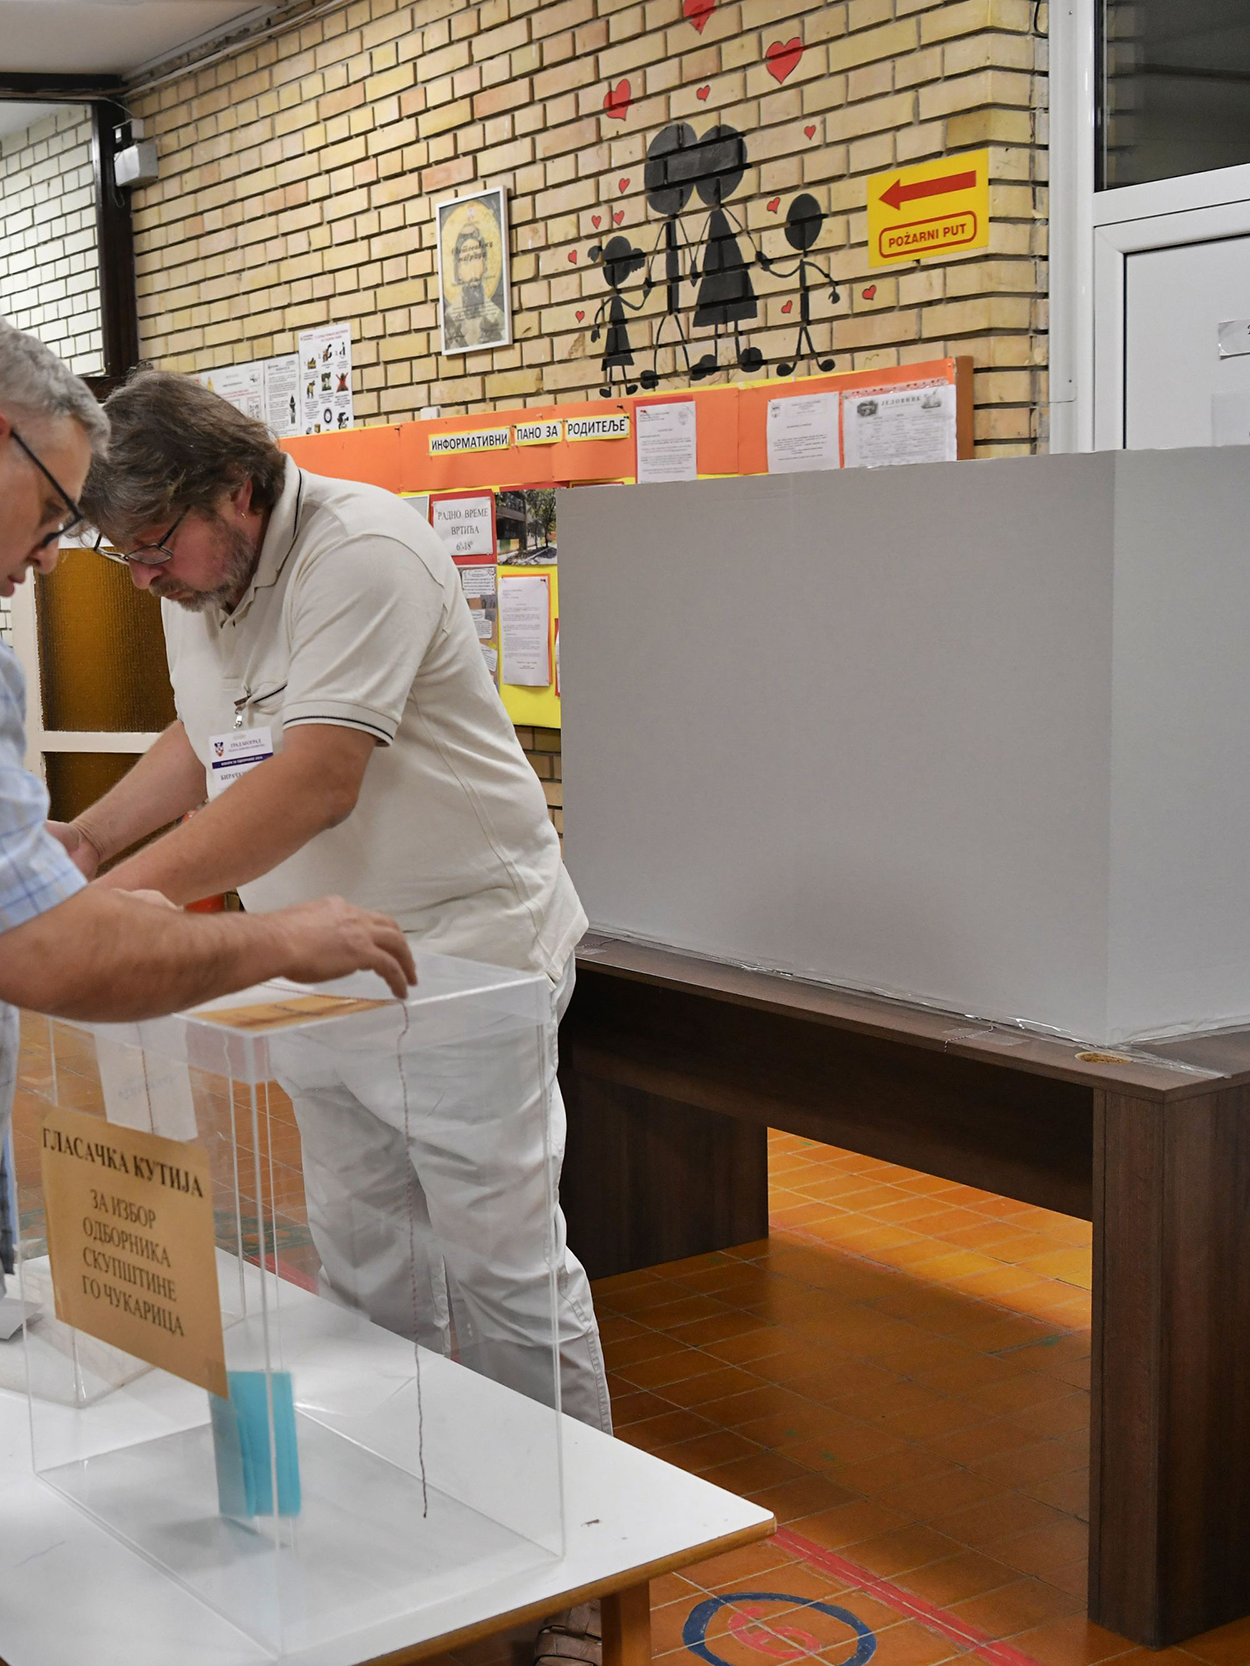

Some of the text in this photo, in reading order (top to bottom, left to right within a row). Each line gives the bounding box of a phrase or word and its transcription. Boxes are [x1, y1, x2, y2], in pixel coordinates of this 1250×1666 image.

[888, 223, 967, 248] POŽARNI PUT
[431, 419, 626, 451] ИНФОРМАТИВНИ ПАНО ЗА РОДИТЕЉЕ
[437, 508, 489, 520] РАДНО ВРЕМЕ
[451, 526, 480, 536] ВРТИЋА
[42, 1128, 204, 1198] ГЛАСАЧКА КУТИЈА
[90, 1188, 156, 1229] ЗА ИЗБОР
[83, 1217, 171, 1268] ОДБОРНИКА
[83, 1247, 177, 1302] СКУПШТИНЕ
[82, 1275, 185, 1337] ГО ЧУКАРИЦА
